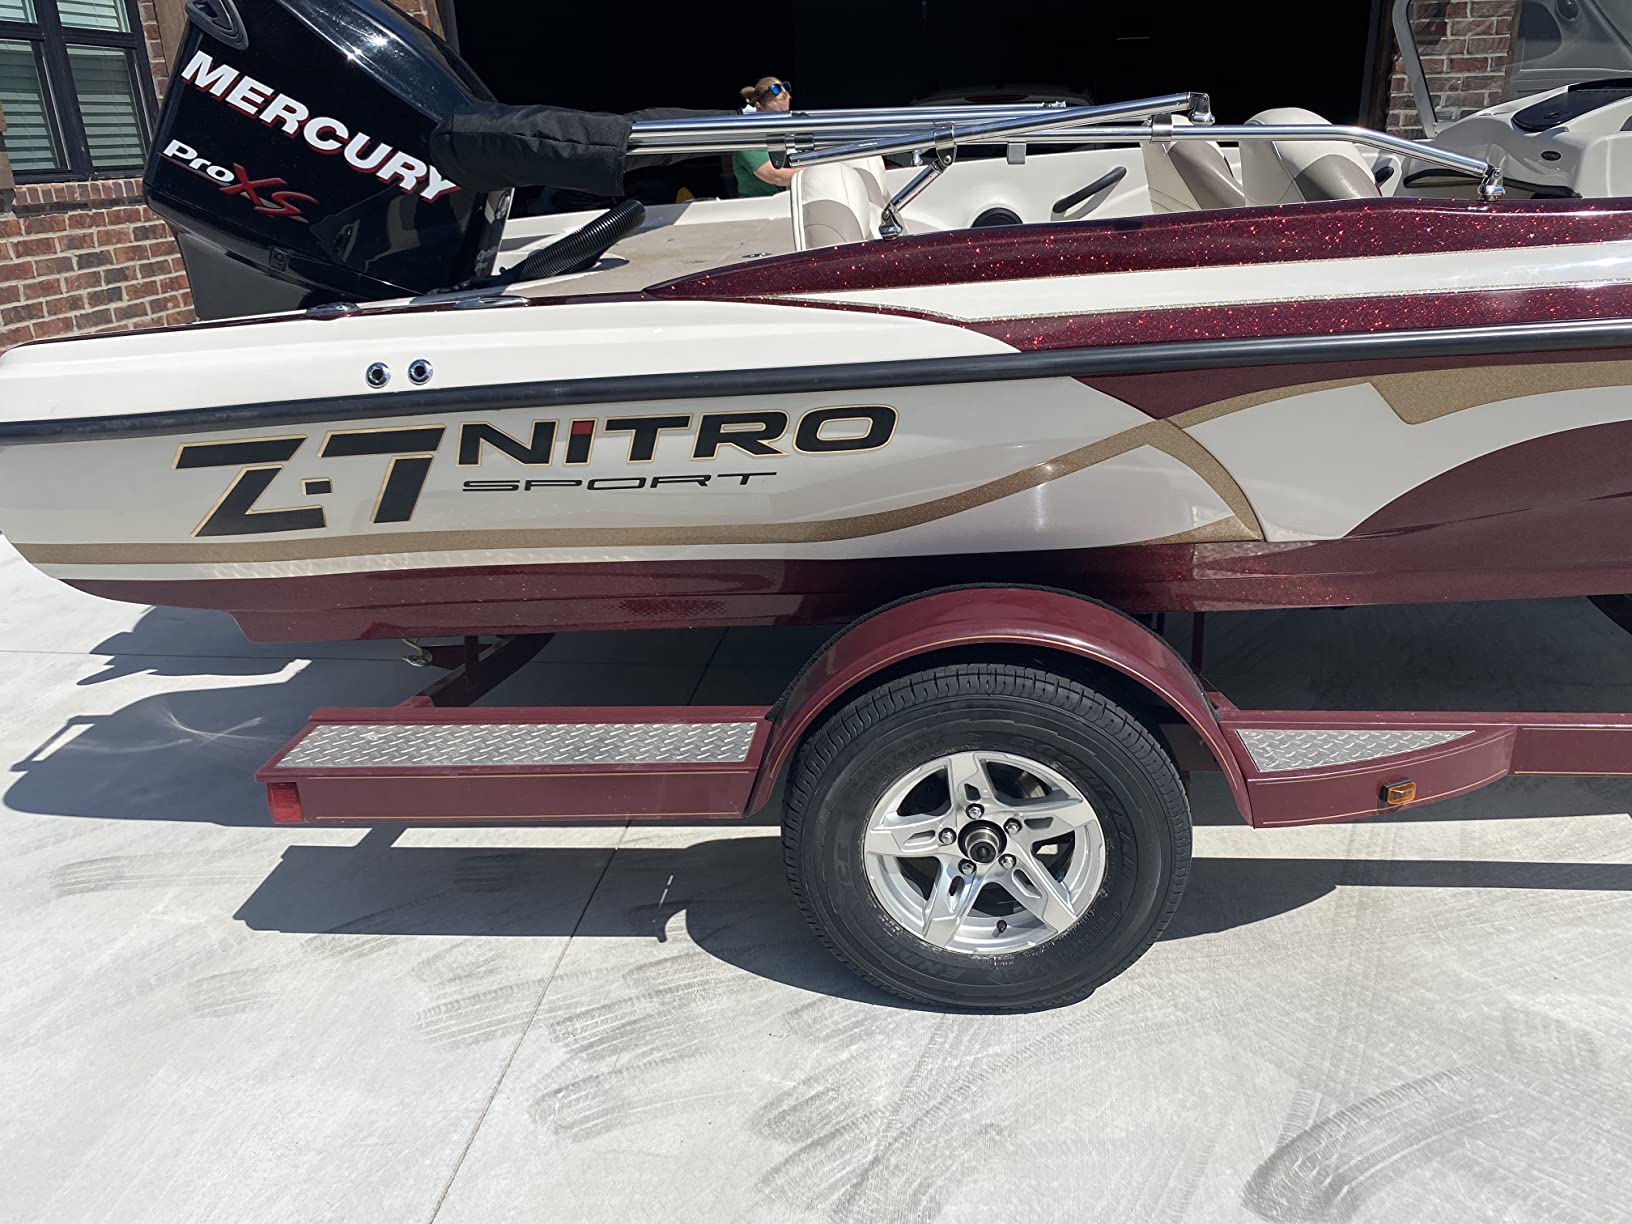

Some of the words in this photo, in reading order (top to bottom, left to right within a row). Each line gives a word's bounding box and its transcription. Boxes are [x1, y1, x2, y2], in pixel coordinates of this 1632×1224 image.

[181, 51, 459, 202] MERCURY
[458, 404, 899, 466] NITRO
[462, 472, 777, 493] SPORT
